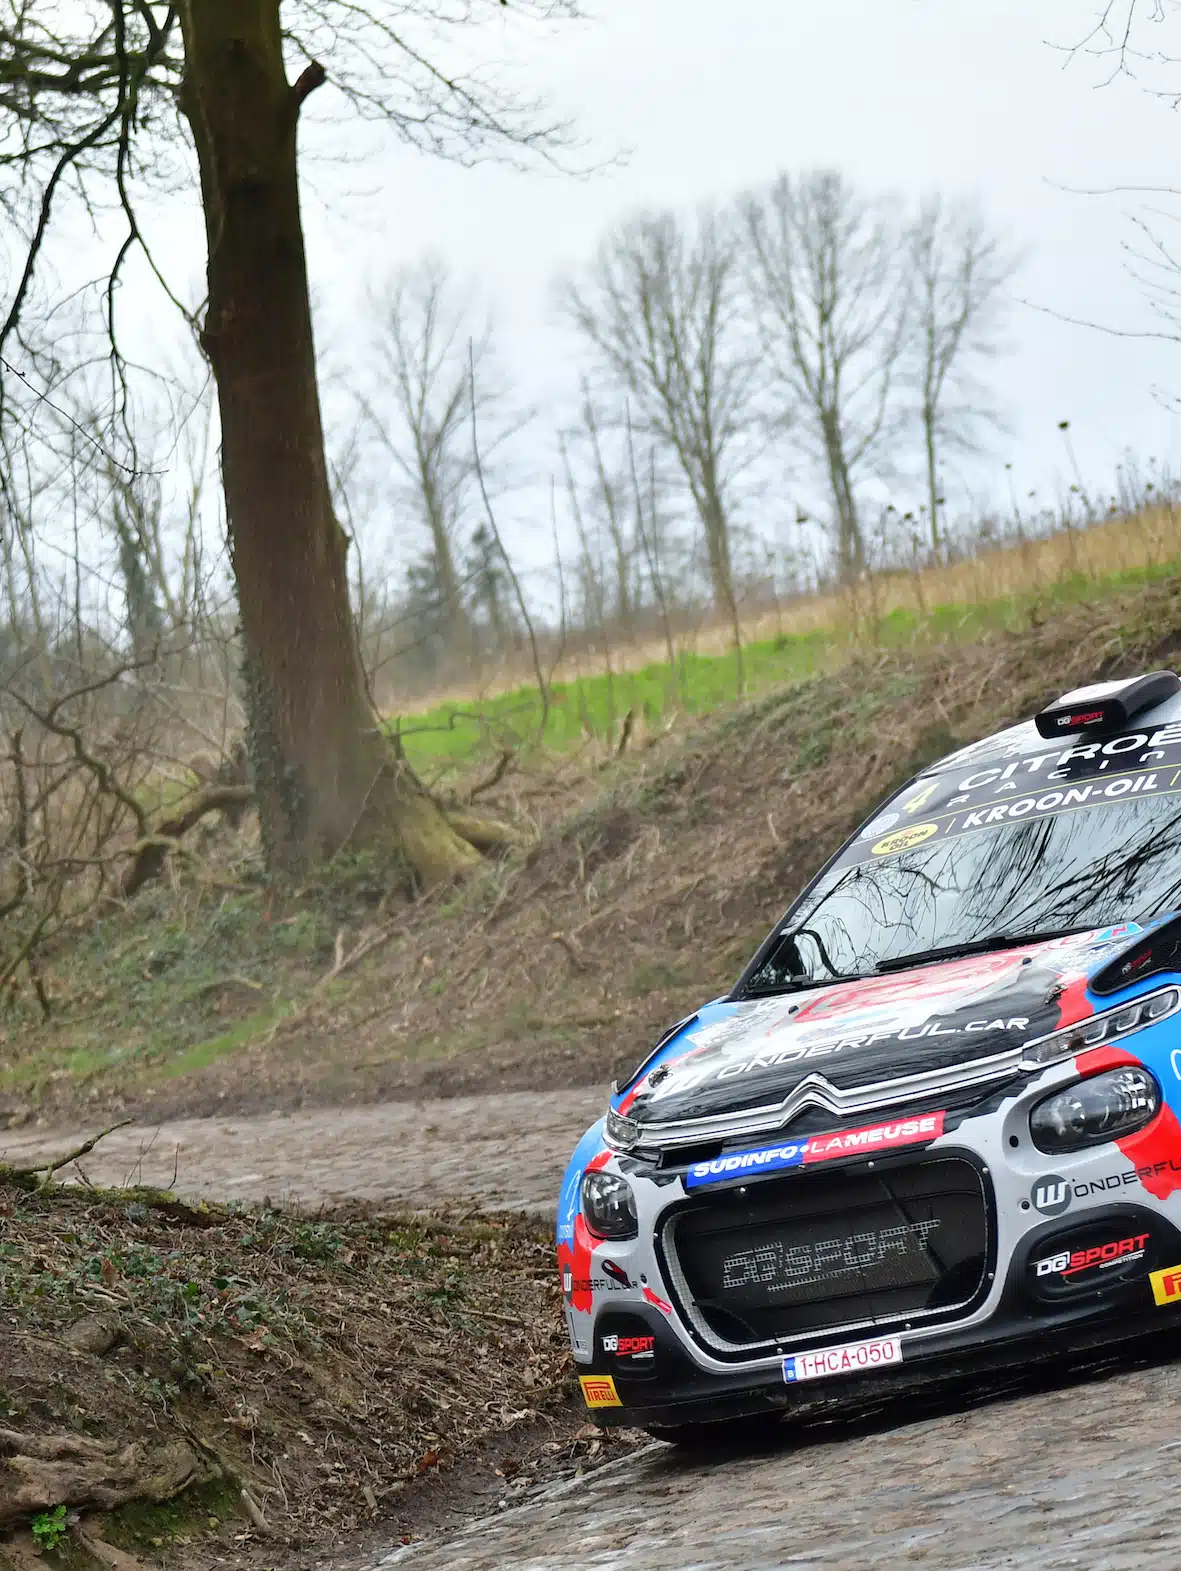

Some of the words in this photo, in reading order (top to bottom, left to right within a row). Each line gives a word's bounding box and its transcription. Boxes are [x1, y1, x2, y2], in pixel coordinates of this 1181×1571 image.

[961, 773, 1158, 830] KROON-OIL
[881, 830, 928, 848] KROON
[800, 1341, 894, 1377] 1-HCA-050
[584, 1381, 617, 1401] PIRELLI
